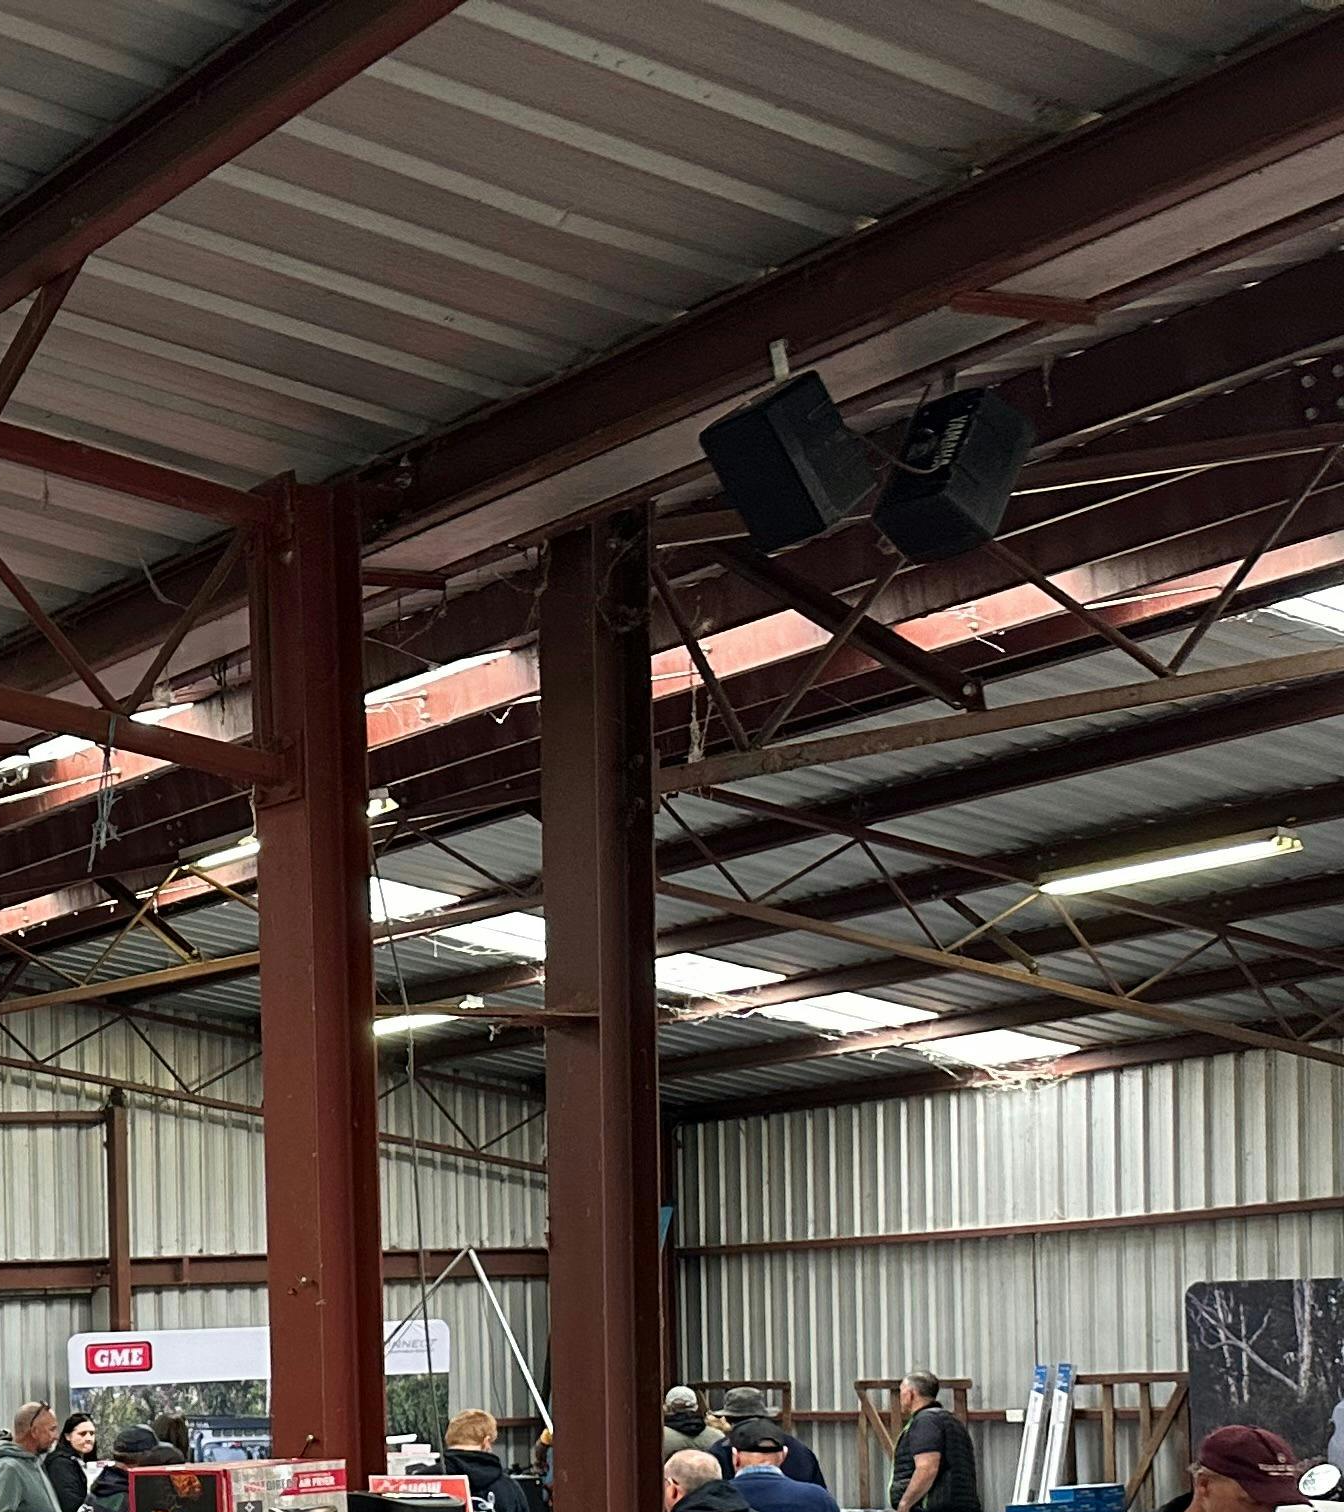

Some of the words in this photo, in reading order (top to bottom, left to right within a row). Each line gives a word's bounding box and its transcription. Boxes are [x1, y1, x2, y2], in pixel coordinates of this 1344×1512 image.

[931, 415, 968, 468] YAMAHA
[93, 1347, 145, 1369] GME
[298, 1476, 310, 1488] AIR
[311, 1475, 336, 1488] FRYER
